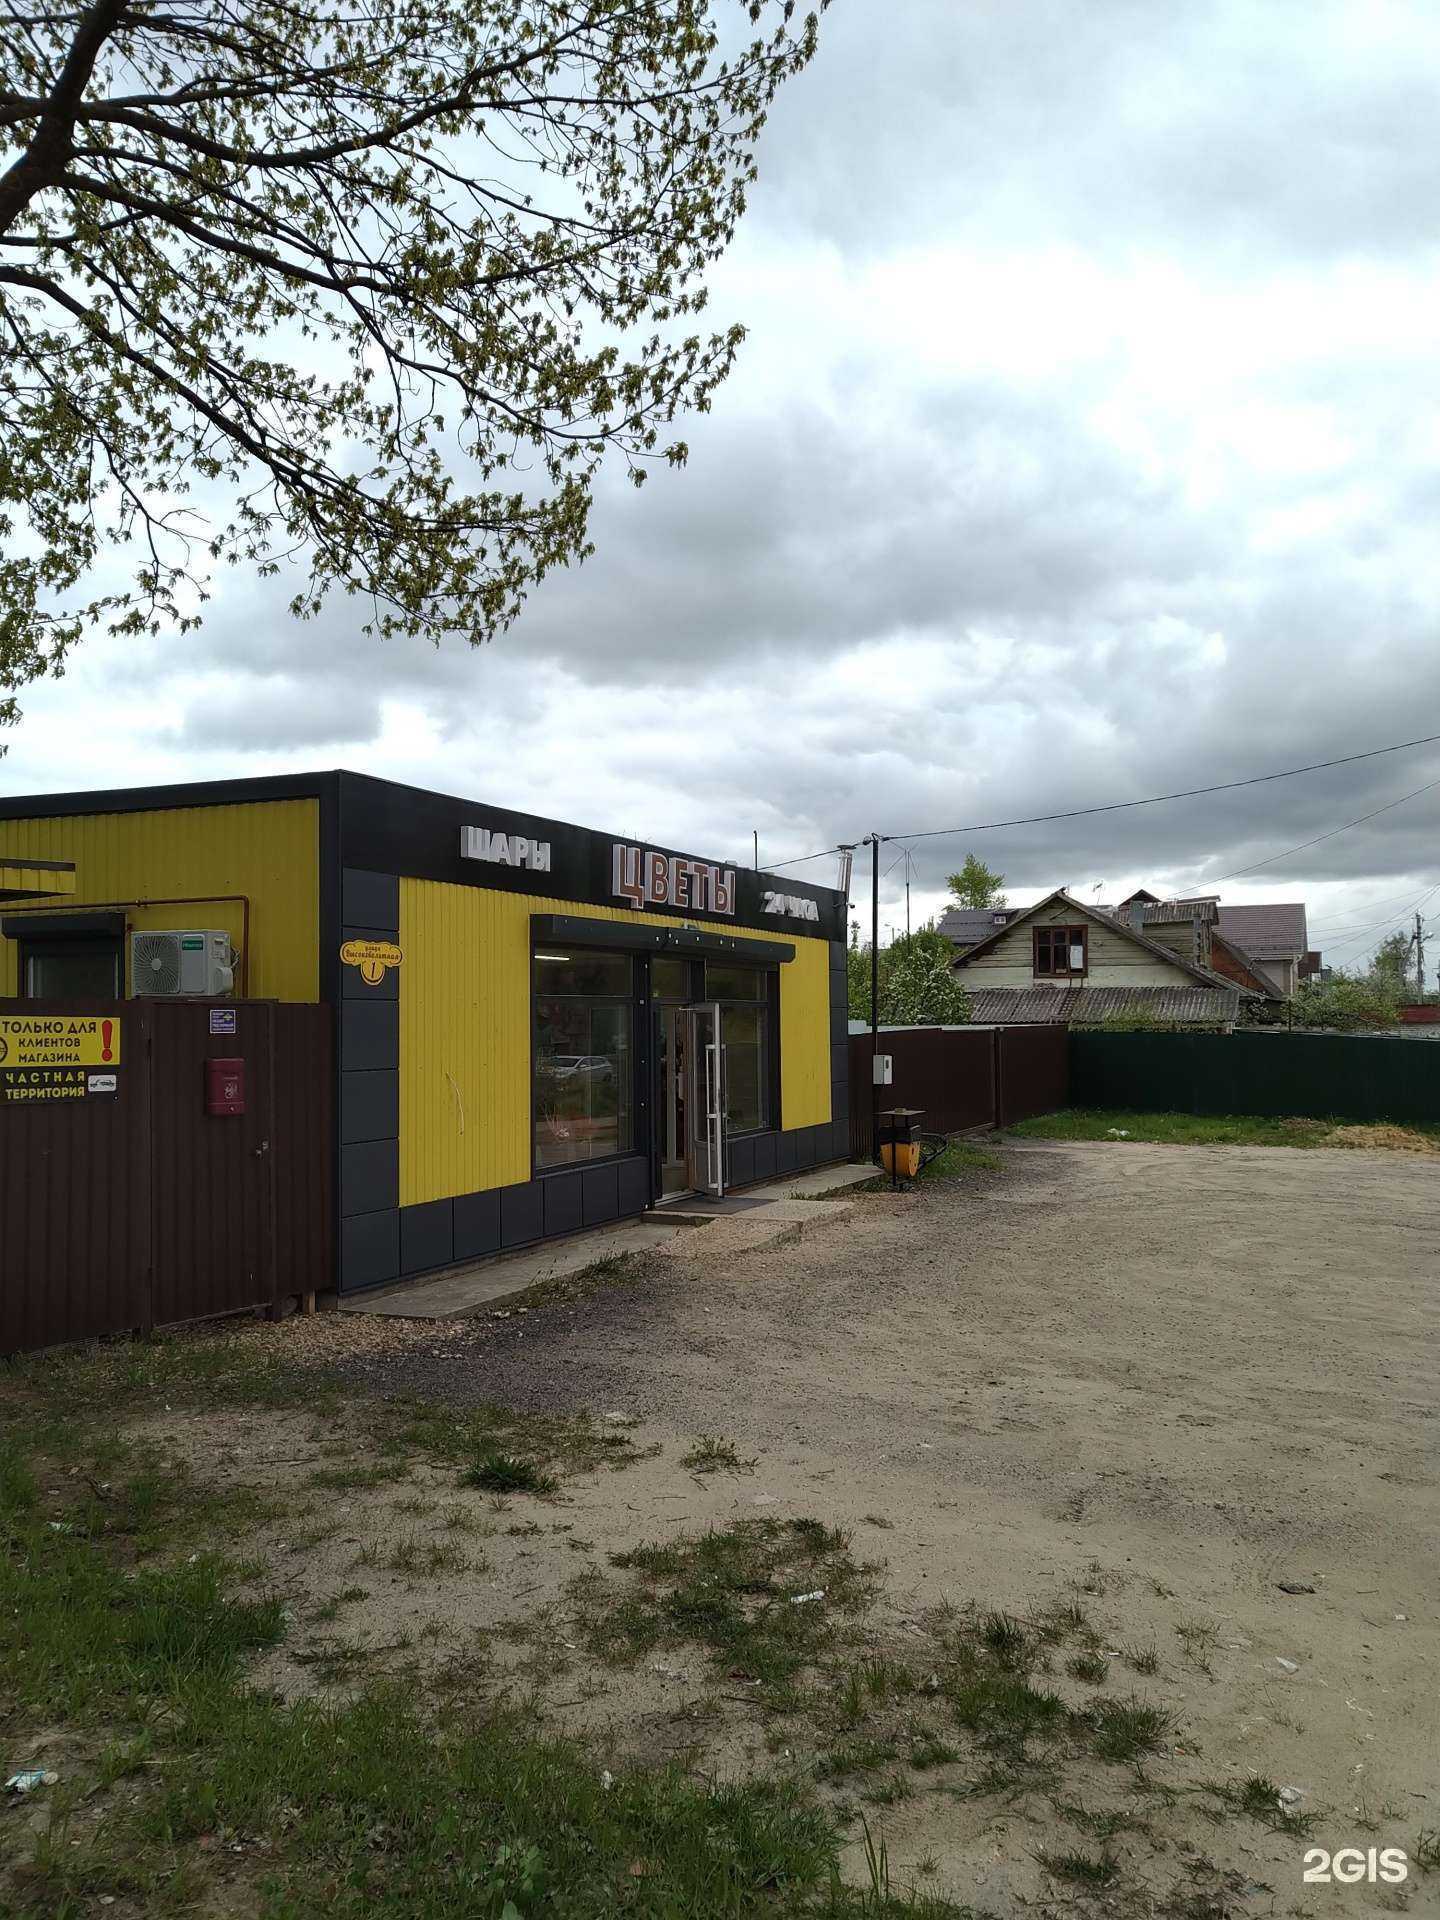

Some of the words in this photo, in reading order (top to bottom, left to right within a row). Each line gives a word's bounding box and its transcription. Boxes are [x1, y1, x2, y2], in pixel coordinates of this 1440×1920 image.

[461, 826, 550, 872] ШАРЫ
[612, 843, 736, 915] ЦВЕТЫ
[2, 1021, 64, 1034] ТОЛЬКО
[67, 1021, 97, 1035] ДЛЯ
[18, 1038, 81, 1048] КЛИЕНТОВ
[18, 1053, 81, 1063] МАГАЗИНА
[5, 1071, 85, 1084] ЧАСТНАЯ
[5, 1086, 85, 1100] ТЕРРИТОРИЯ
